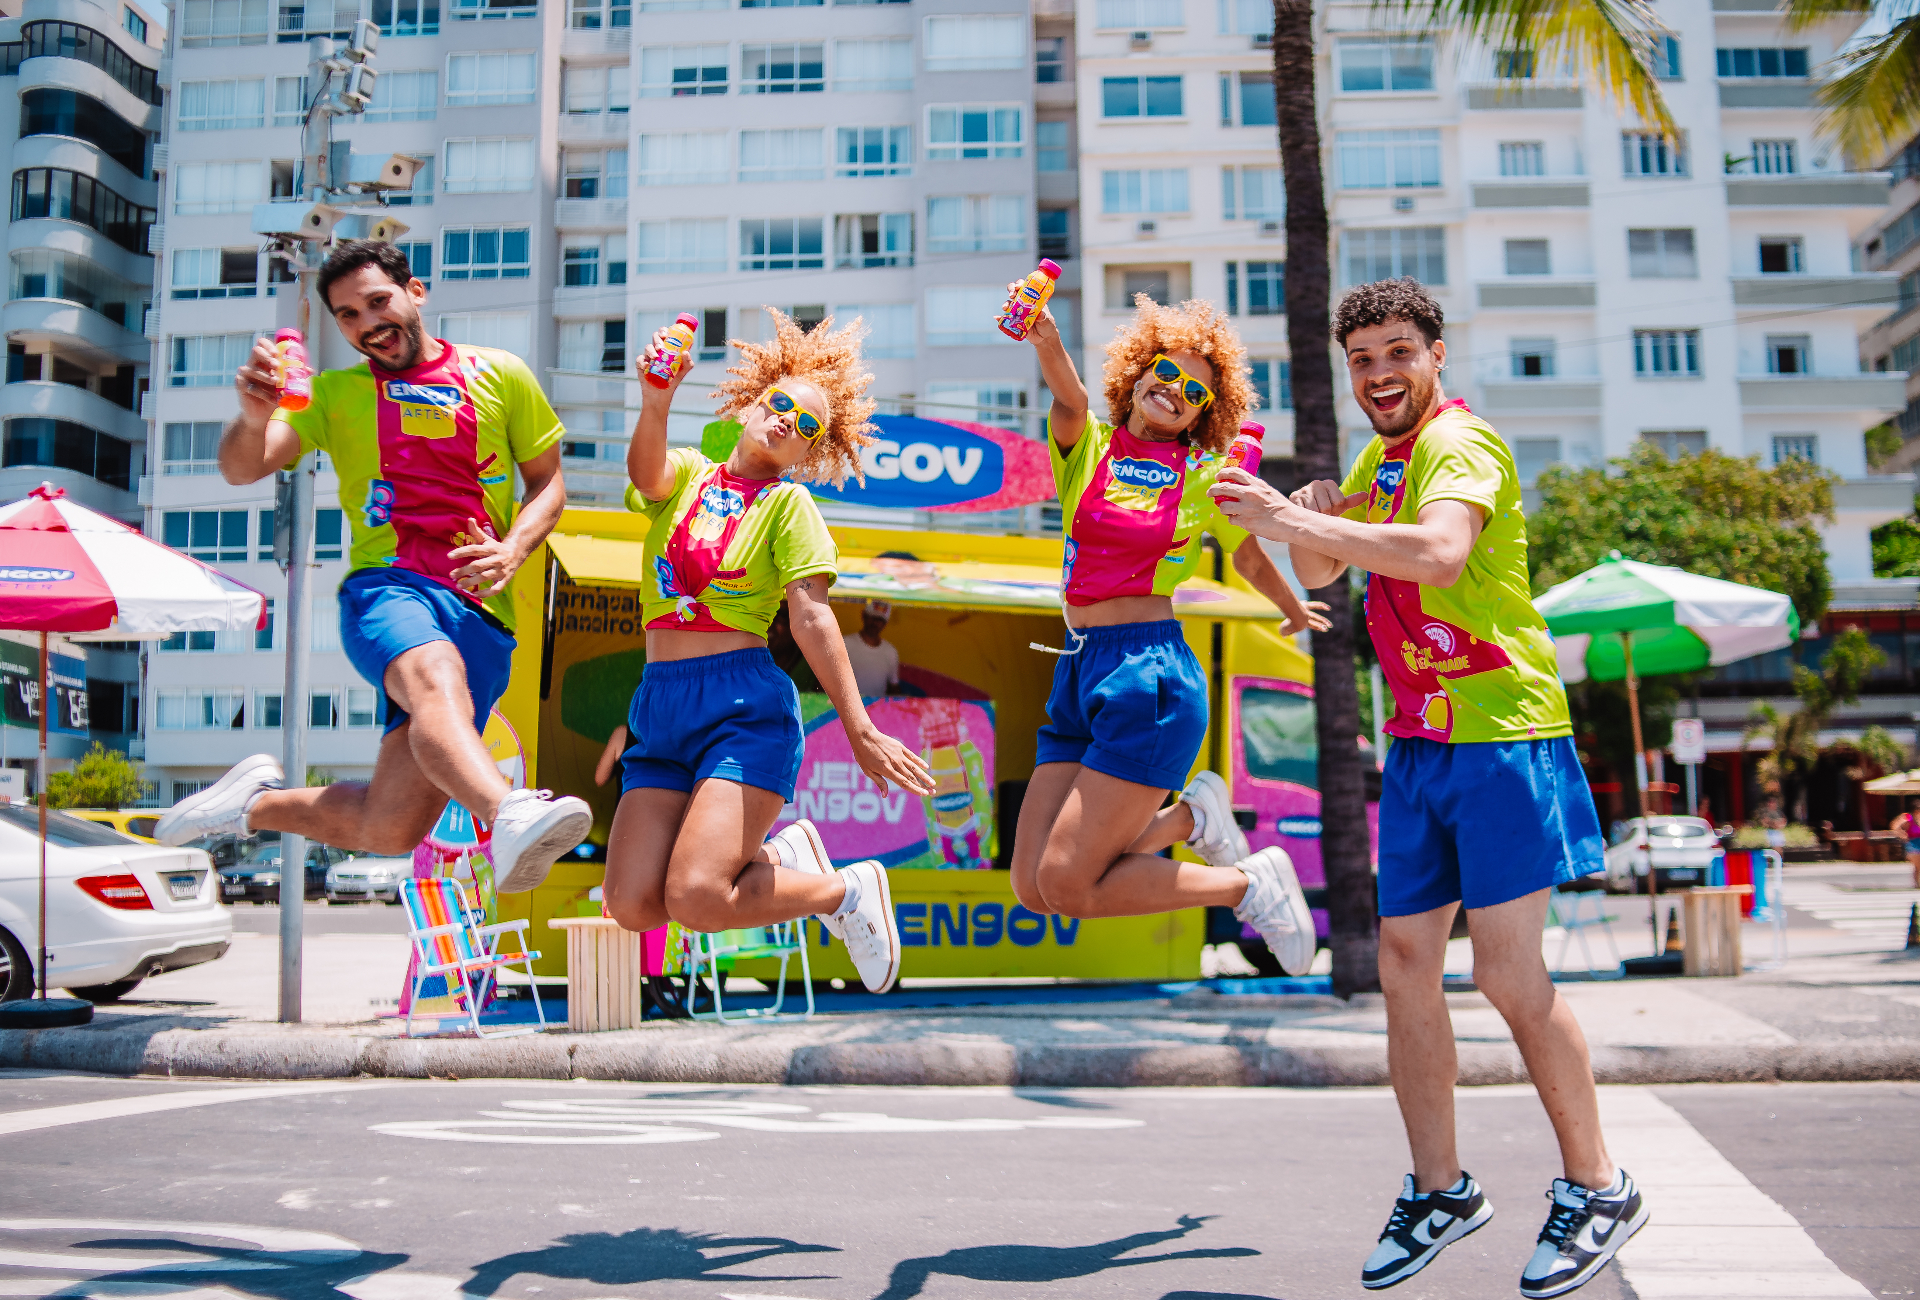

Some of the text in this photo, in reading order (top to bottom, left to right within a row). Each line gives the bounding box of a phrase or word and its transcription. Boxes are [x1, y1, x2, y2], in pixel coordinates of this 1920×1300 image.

[403, 408, 452, 421] AFTER
[853, 438, 983, 485] GOV
[1112, 462, 1175, 483] ENGOV
[0, 569, 71, 580] GOV
[808, 761, 901, 790] JEIT
